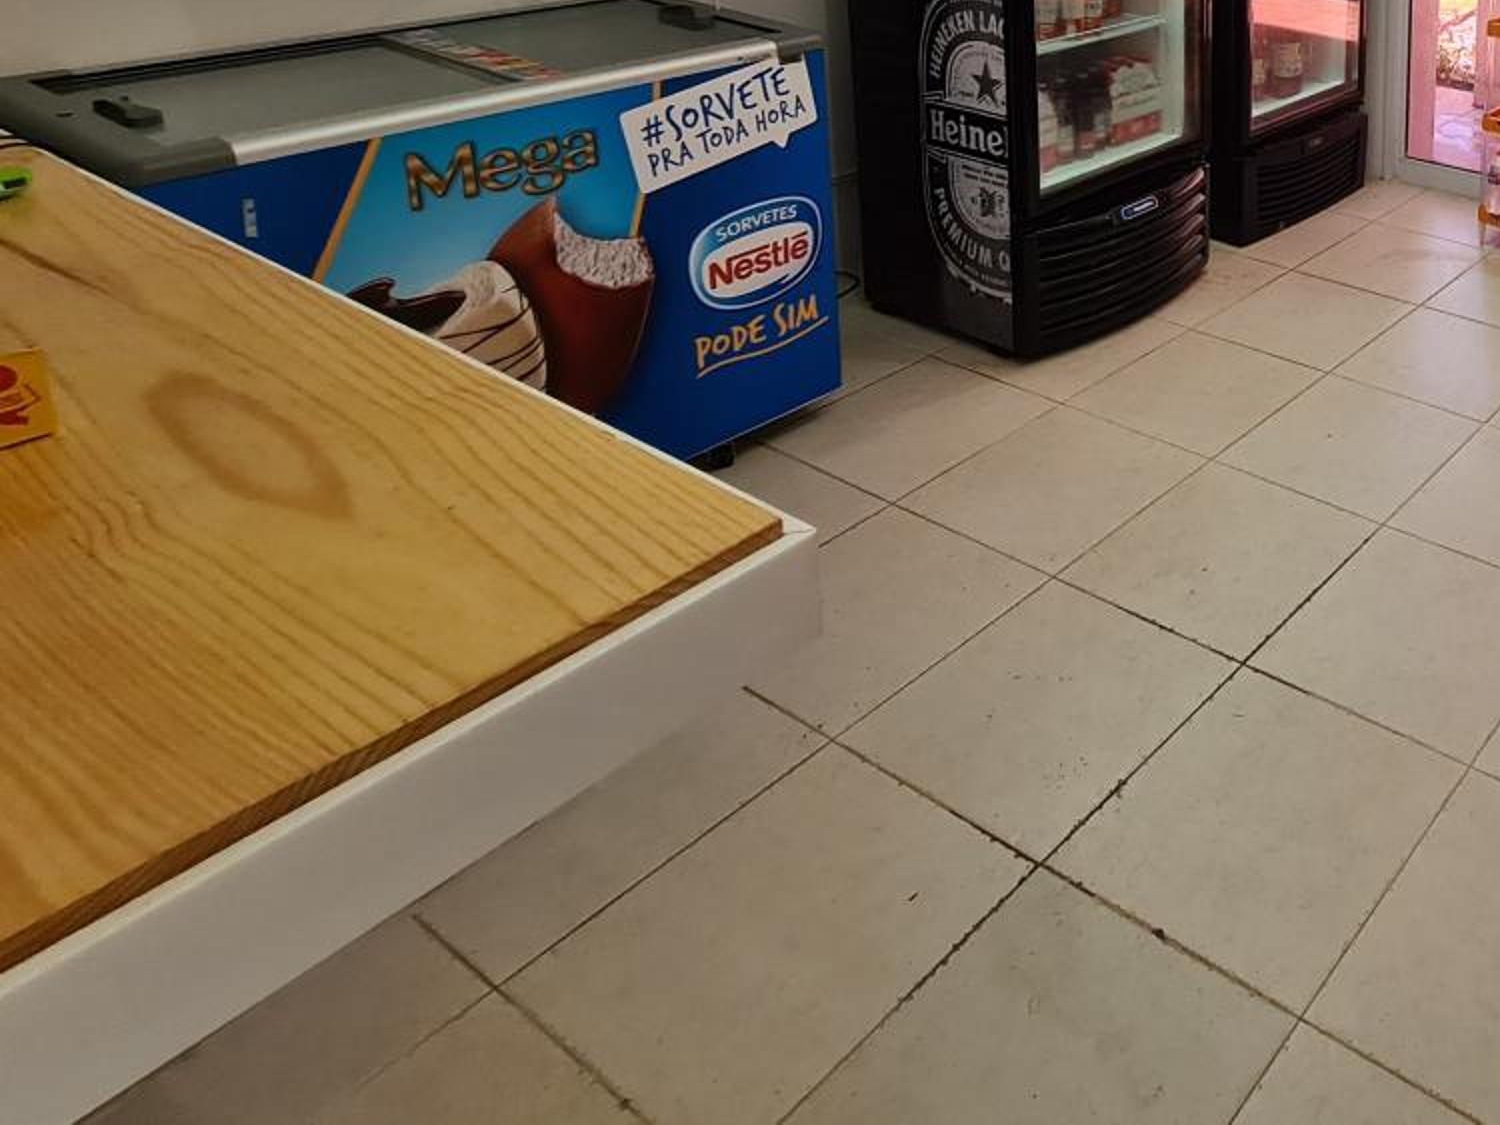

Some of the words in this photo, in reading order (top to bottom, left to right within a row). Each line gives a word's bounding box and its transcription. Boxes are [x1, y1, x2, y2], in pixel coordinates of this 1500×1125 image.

[929, 9, 976, 78] HEINEKEN
[641, 66, 791, 147] #SORVETE
[648, 145, 694, 177] PRA
[699, 119, 749, 154] TODA
[755, 94, 808, 133] HORA
[929, 107, 1009, 159] Heine
[404, 128, 600, 212] Mega
[708, 231, 810, 290] Nestlé
[715, 204, 798, 243] SORVETES
[932, 186, 993, 269] PREMIUM
[694, 315, 766, 369] PODE
[774, 293, 819, 337] SIM
